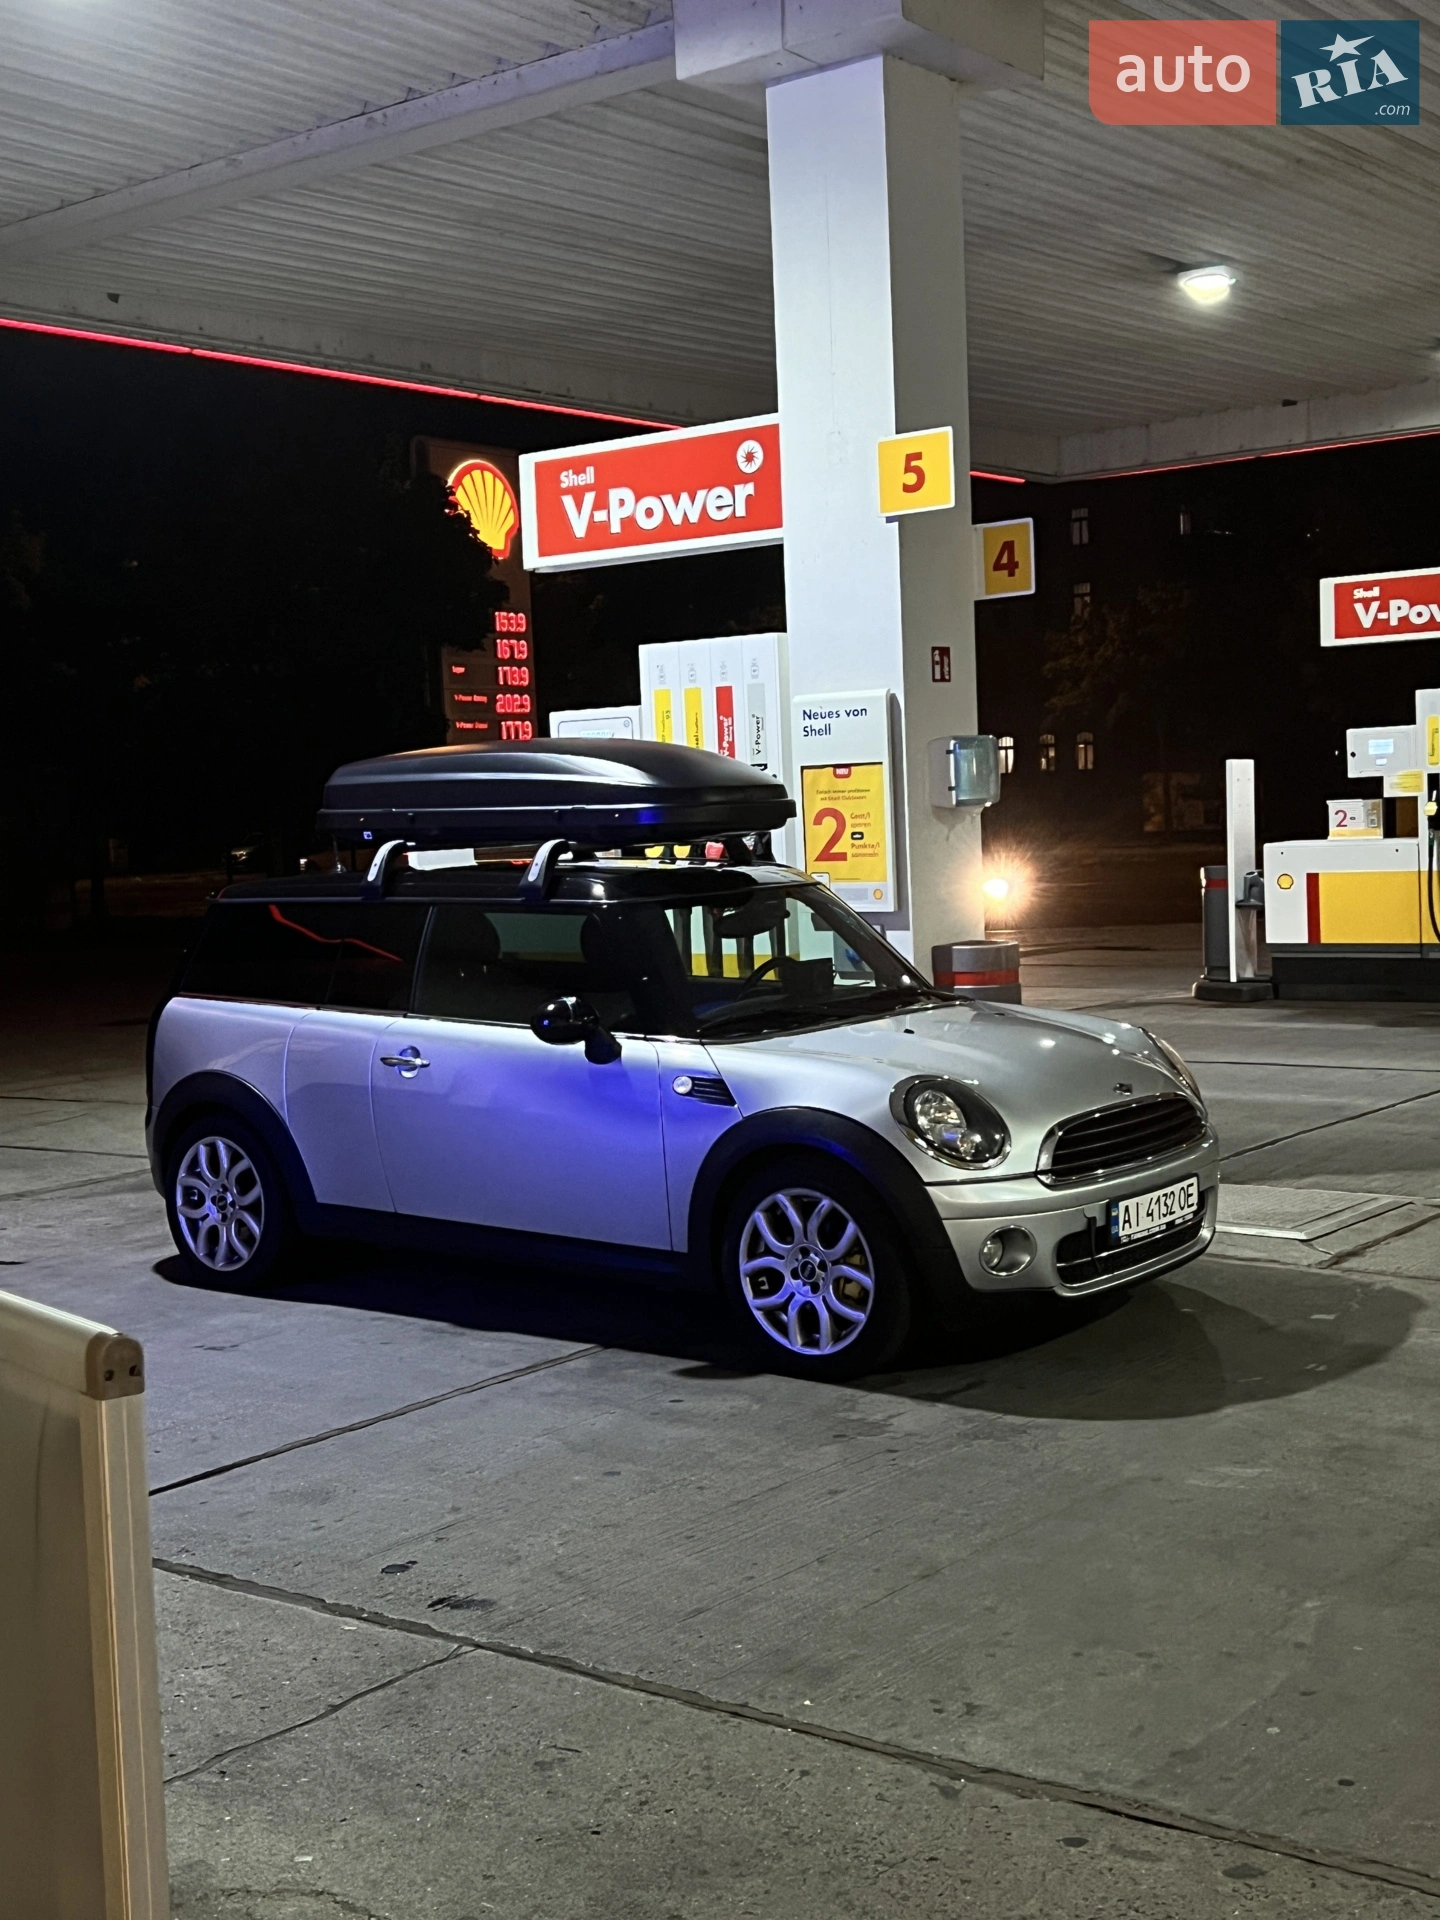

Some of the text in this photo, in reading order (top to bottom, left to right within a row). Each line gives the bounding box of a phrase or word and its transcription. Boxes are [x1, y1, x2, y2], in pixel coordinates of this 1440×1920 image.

[559, 466, 595, 488] Shell
[902, 451, 926, 494] 5
[560, 482, 755, 539] V-Power
[992, 540, 1019, 578] 4
[1353, 586, 1380, 599] Shell
[802, 708, 867, 721] Neues von
[803, 723, 831, 737] Shell
[1334, 809, 1348, 828] 2
[812, 807, 848, 862] 2
[1122, 1202, 1140, 1231] AI
[1146, 1190, 1176, 1222] 4132
[1179, 1182, 1195, 1211] OE
